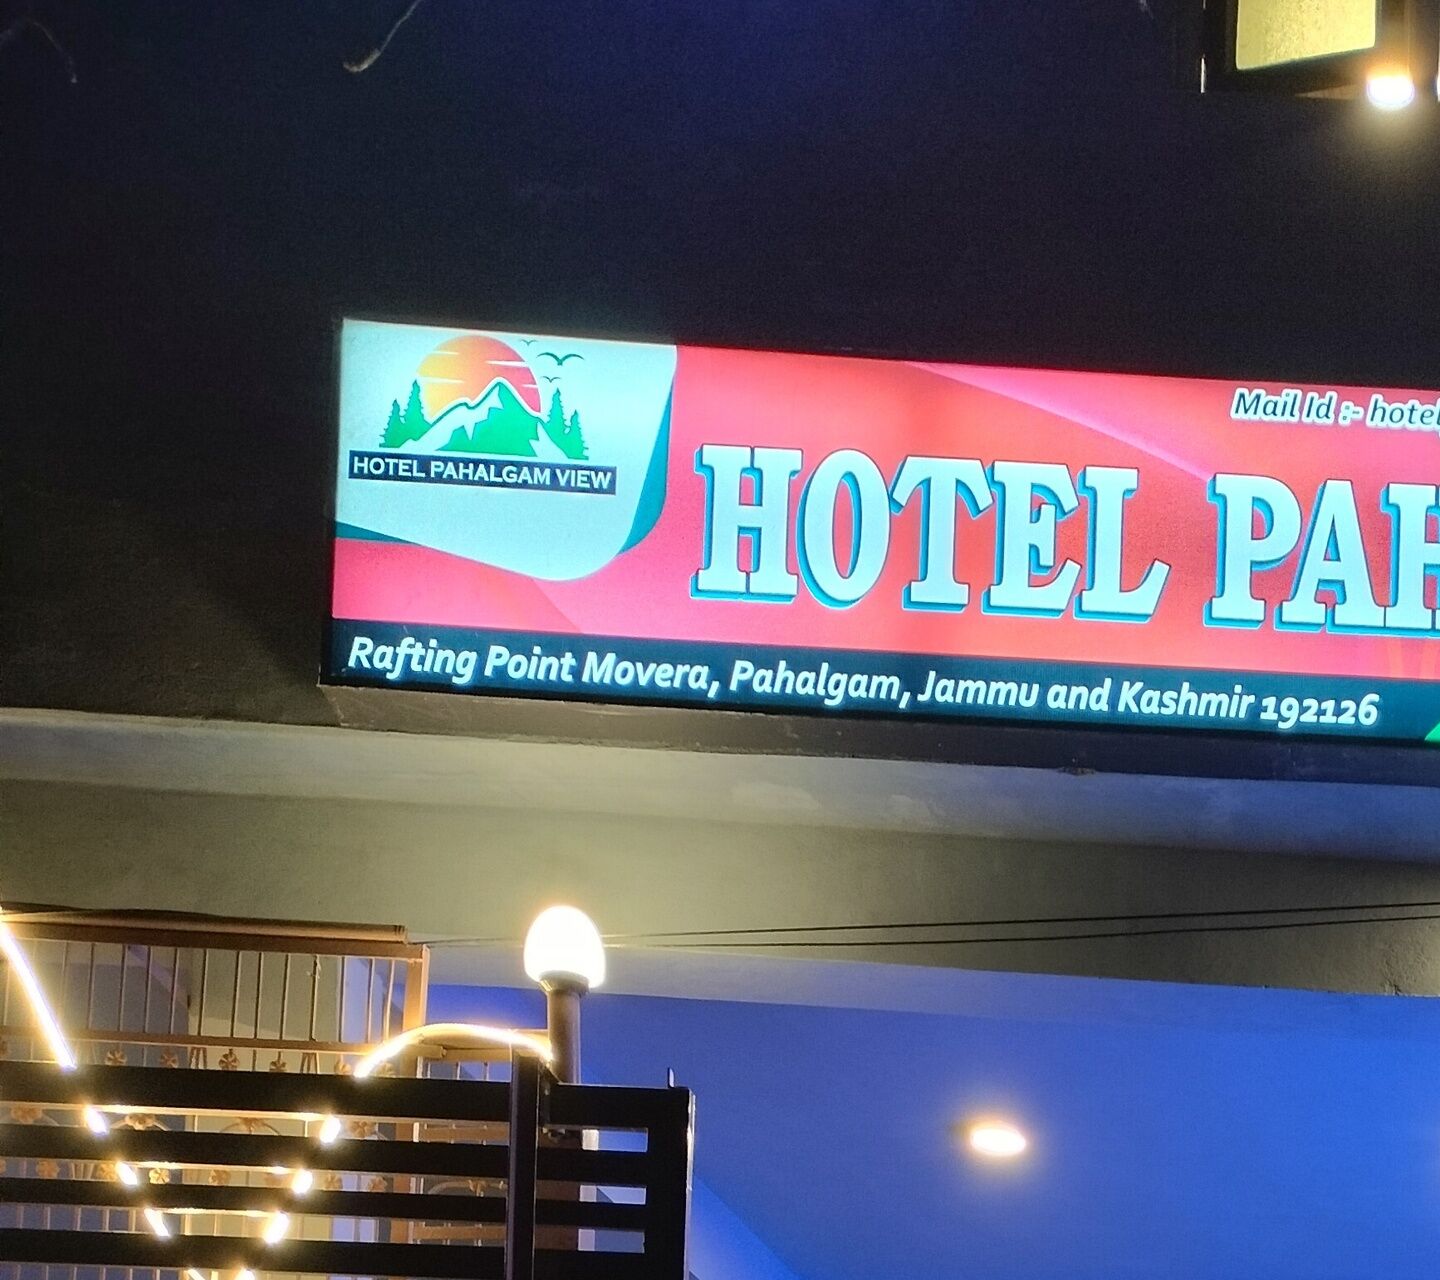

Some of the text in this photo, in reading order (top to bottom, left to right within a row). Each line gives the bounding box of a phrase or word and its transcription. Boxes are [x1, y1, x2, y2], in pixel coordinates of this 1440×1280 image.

[1232, 390, 1300, 418] Mail
[1304, 392, 1337, 421] Id
[353, 456, 612, 490] HOTEL PAHALGAM VIEW
[690, 443, 1172, 623] HOTEL
[348, 635, 1381, 730] Rafting Point Movera, Pahalgam, Jammu and Kashmir 192126
